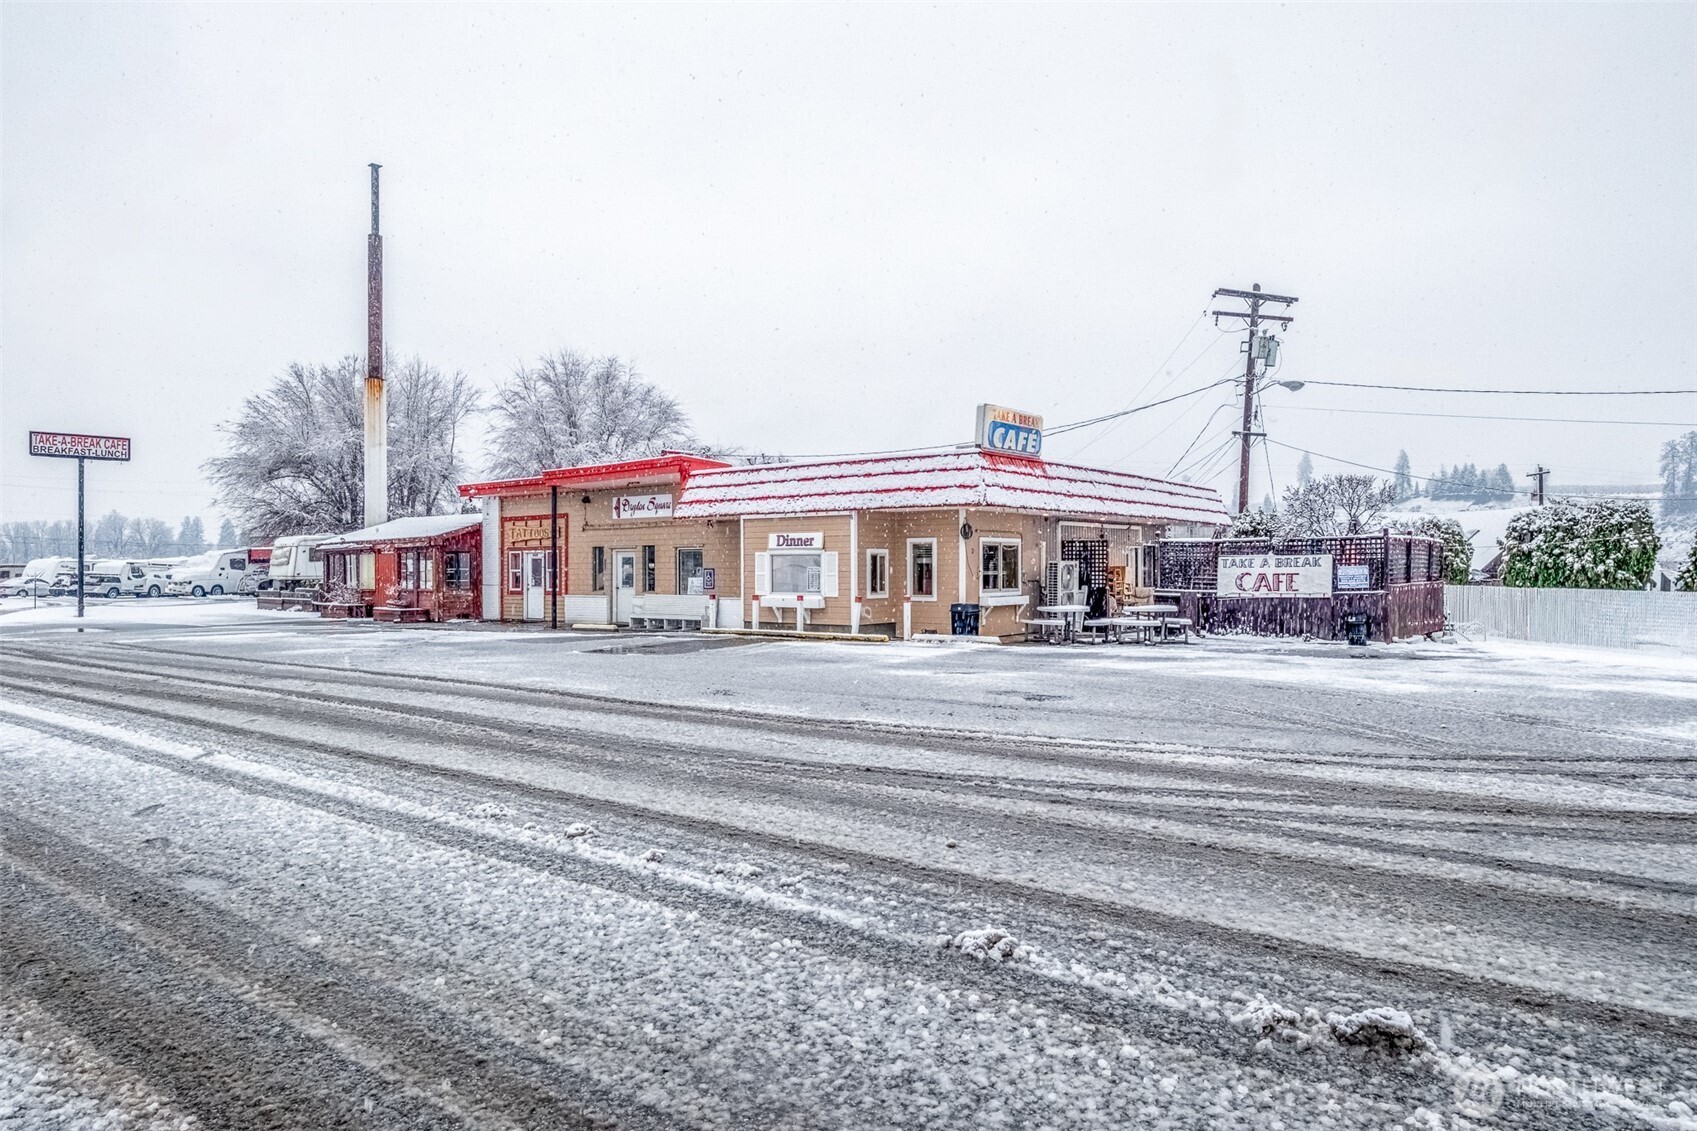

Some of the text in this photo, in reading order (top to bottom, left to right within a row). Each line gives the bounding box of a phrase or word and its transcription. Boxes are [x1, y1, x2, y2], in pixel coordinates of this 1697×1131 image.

[1012, 413, 1017, 424] A
[33, 433, 127, 451] TAKE-A-BREAK CAFE
[993, 427, 1037, 453] CAFÉ
[32, 445, 127, 458] BREAKFAST-LUNCH
[646, 497, 671, 515] Square
[510, 528, 550, 539] TATTOOS
[776, 534, 815, 547] Dinner
[1221, 557, 1322, 569] TAKE A BREAK
[1235, 572, 1300, 592] CAFE
